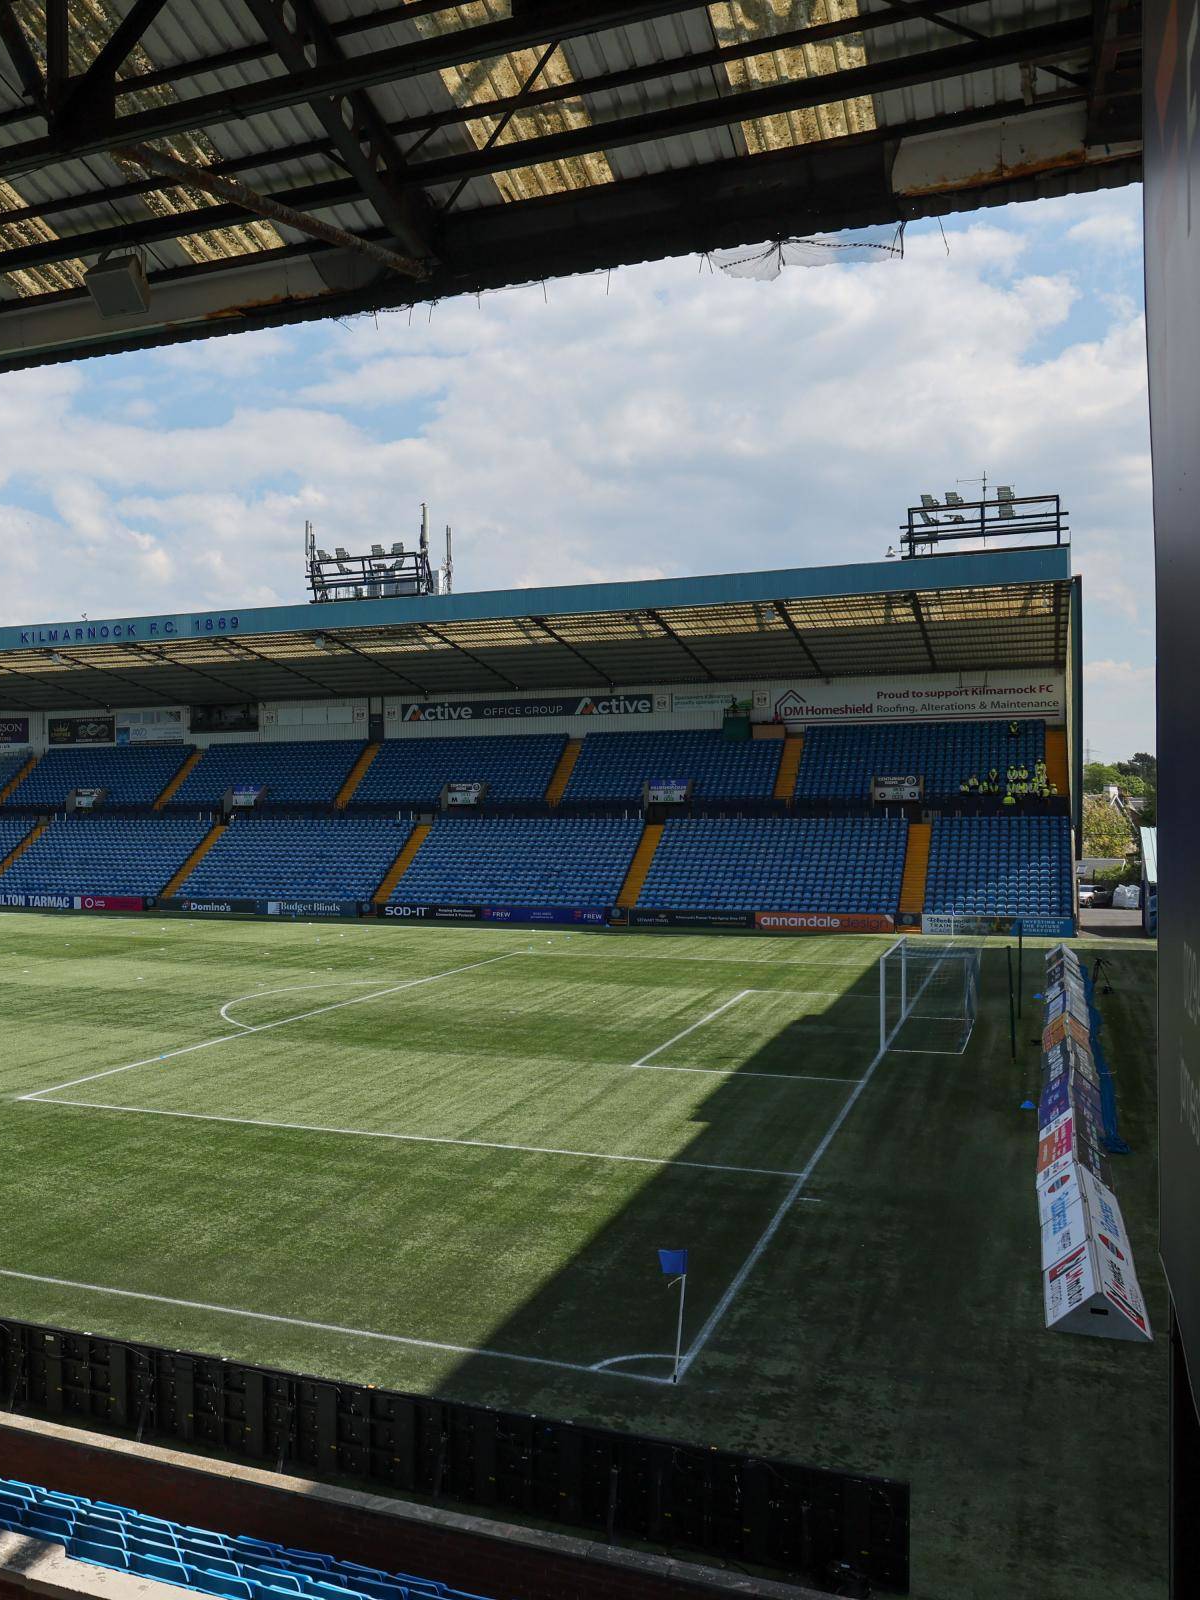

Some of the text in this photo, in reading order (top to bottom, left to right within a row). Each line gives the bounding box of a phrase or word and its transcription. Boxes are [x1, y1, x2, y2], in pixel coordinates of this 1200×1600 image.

[20, 615, 240, 648] KILMARNOCK F.C. 1869
[877, 685, 1053, 699] Proud to support Kilmarnock FC
[403, 703, 563, 720] Active OFFICE GROUP
[575, 696, 651, 716] Active
[784, 704, 873, 716] DM Homeshield
[920, 702, 976, 711] Alterations
[979, 701, 987, 710] &
[990, 700, 1060, 709] Maintenance
[28, 896, 70, 908] TARMAC
[190, 902, 231, 911] Domino's
[281, 902, 341, 912] Budget Blinds
[384, 906, 429, 917] SOD-IT
